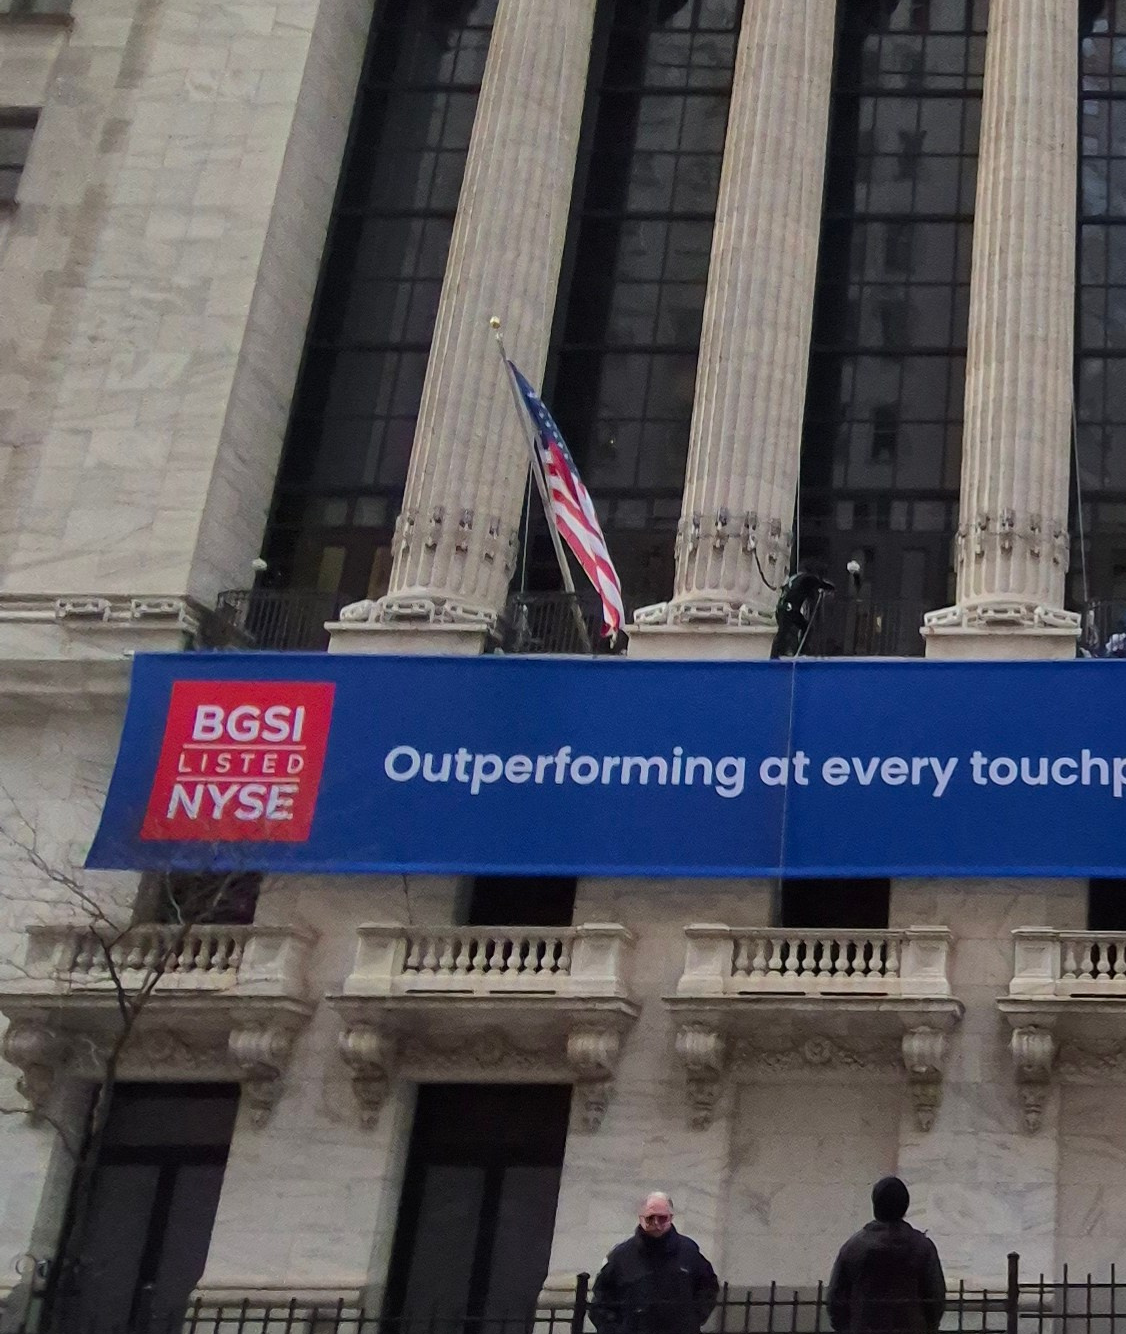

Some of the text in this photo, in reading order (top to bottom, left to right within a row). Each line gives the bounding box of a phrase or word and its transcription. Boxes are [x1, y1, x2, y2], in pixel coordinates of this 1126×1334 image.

[191, 704, 306, 743] BGSI
[177, 751, 305, 774] LISTED
[383, 745, 746, 799] Outperforming
[760, 750, 811, 787] at
[822, 755, 959, 798] every
[166, 783, 297, 822] NYSE
